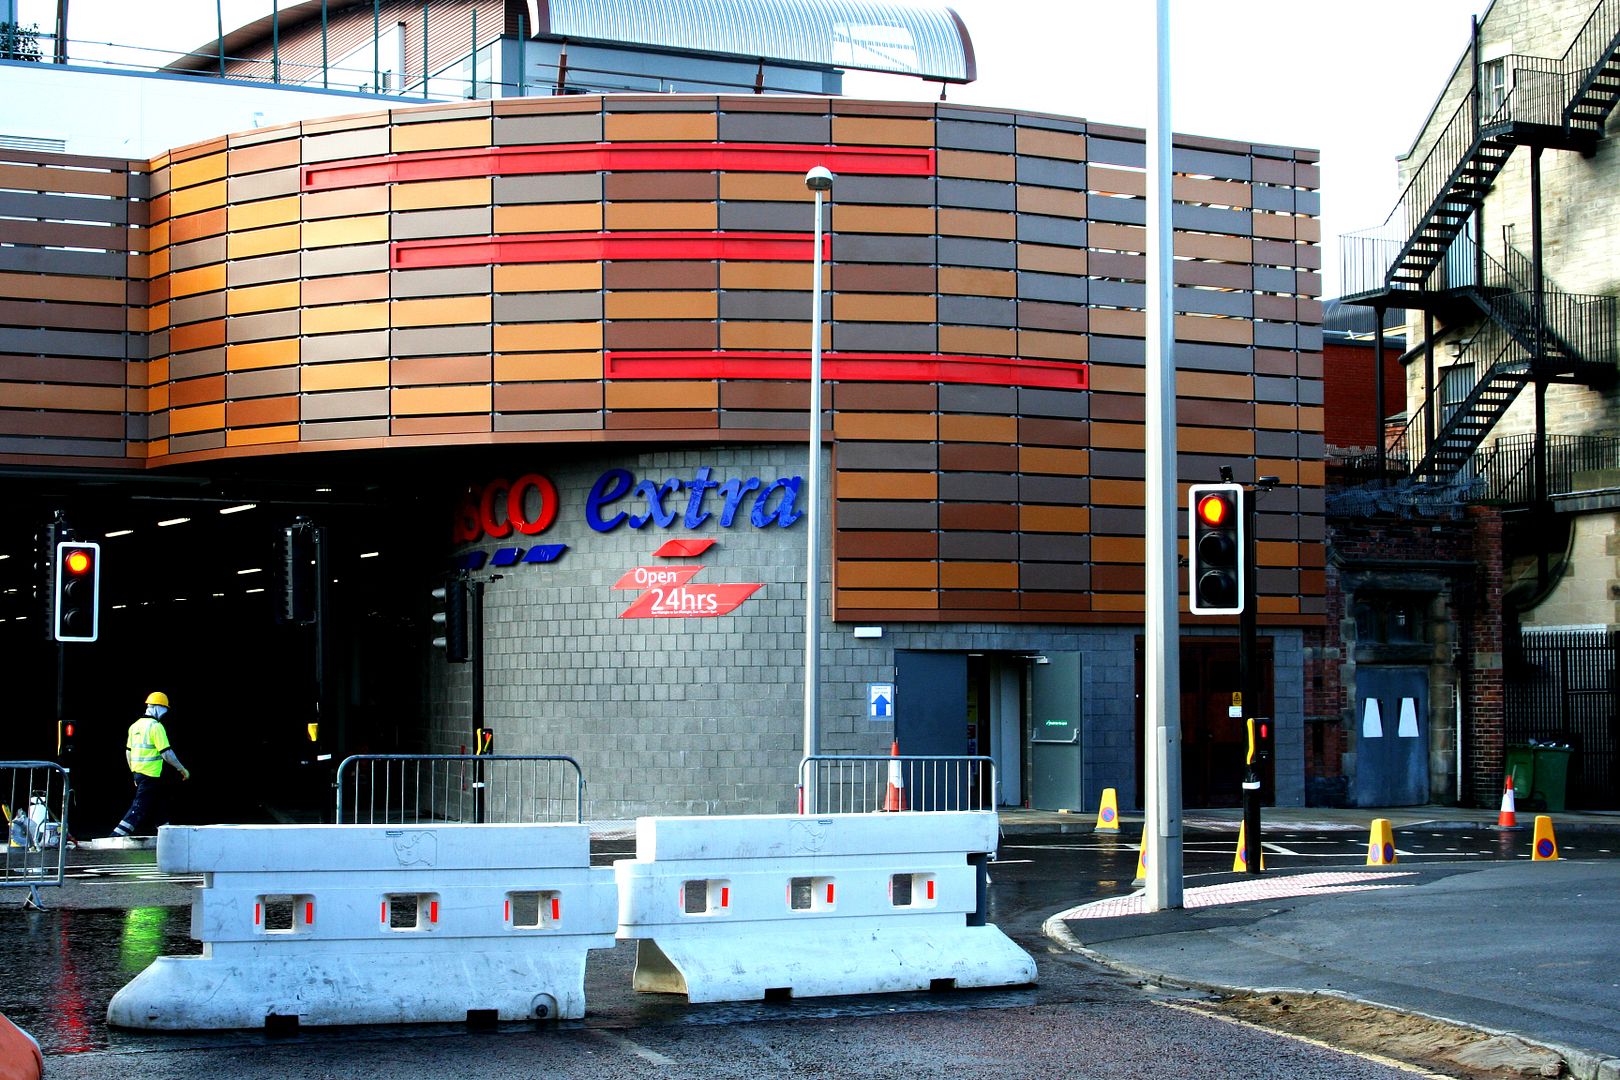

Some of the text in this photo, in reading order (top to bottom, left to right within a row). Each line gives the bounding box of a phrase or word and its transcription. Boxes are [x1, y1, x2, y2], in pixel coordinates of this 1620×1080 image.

[585, 466, 802, 533] extra
[635, 567, 677, 586] Open
[651, 587, 718, 610] 24hrs
